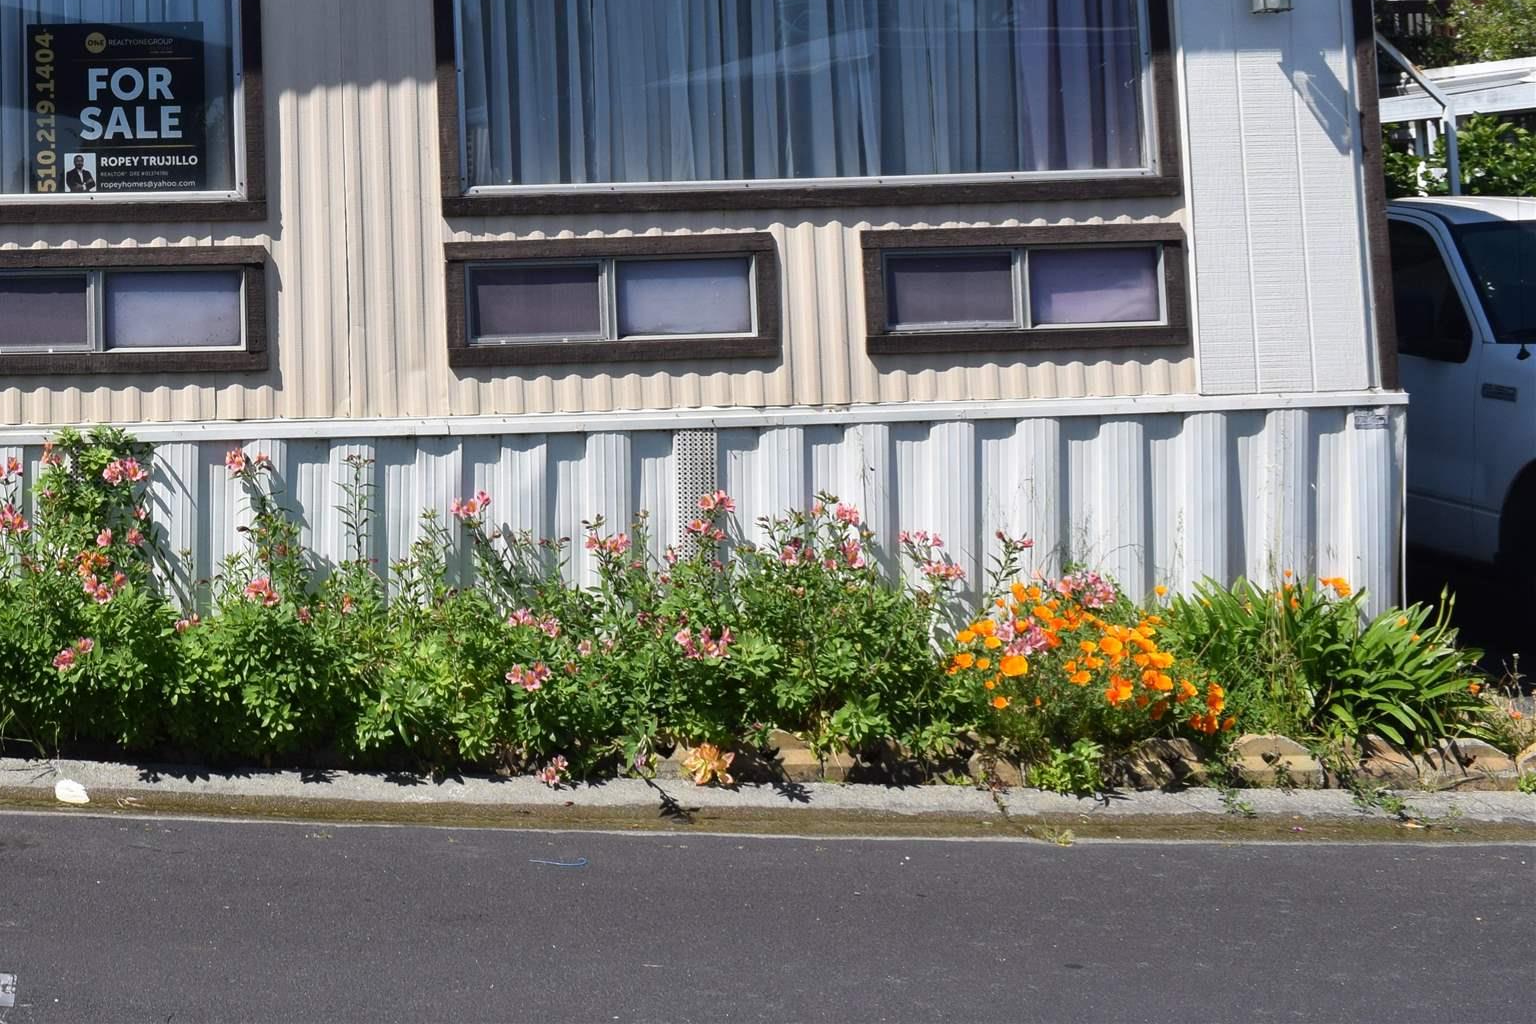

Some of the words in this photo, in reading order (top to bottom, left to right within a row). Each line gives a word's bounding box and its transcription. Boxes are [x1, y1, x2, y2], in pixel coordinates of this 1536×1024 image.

[87, 39, 105, 47] ONE
[88, 67, 175, 102] FOR
[35, 31, 57, 193] 510.219.1404
[79, 105, 183, 141] SALE
[100, 156, 140, 167] ROPEY
[141, 155, 198, 166] TRUJILLO
[100, 180, 196, 189] ropeyhomes@yahoo.com
